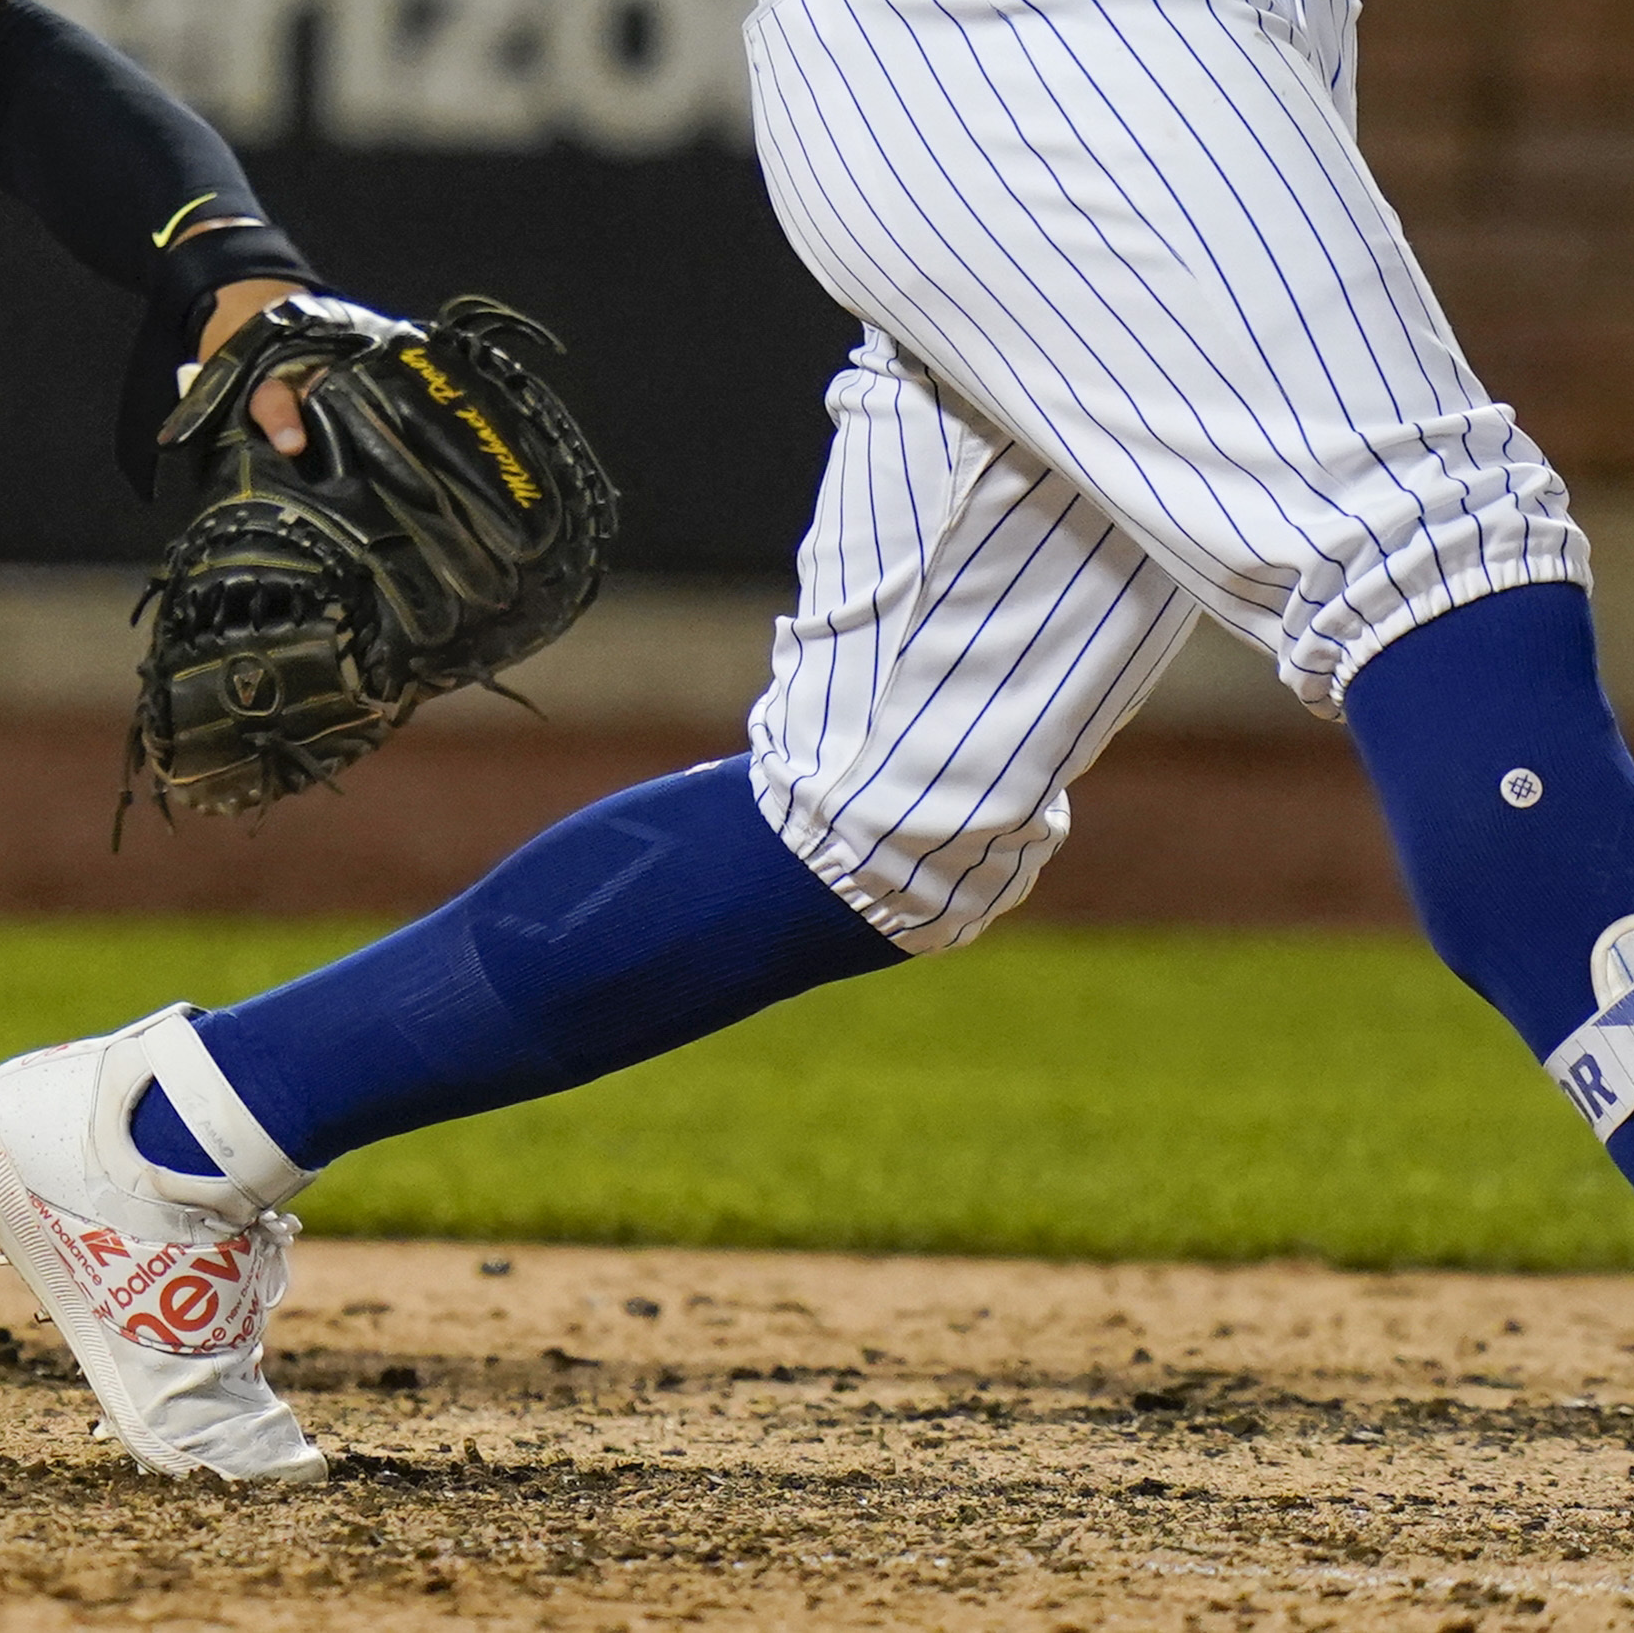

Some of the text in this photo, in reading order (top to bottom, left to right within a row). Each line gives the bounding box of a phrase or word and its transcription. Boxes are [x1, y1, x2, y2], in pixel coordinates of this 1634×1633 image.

[455, 407, 542, 509] Michael
[51, 1218, 103, 1287] balance
[108, 1243, 195, 1311] balan
[120, 1235, 252, 1353] new
